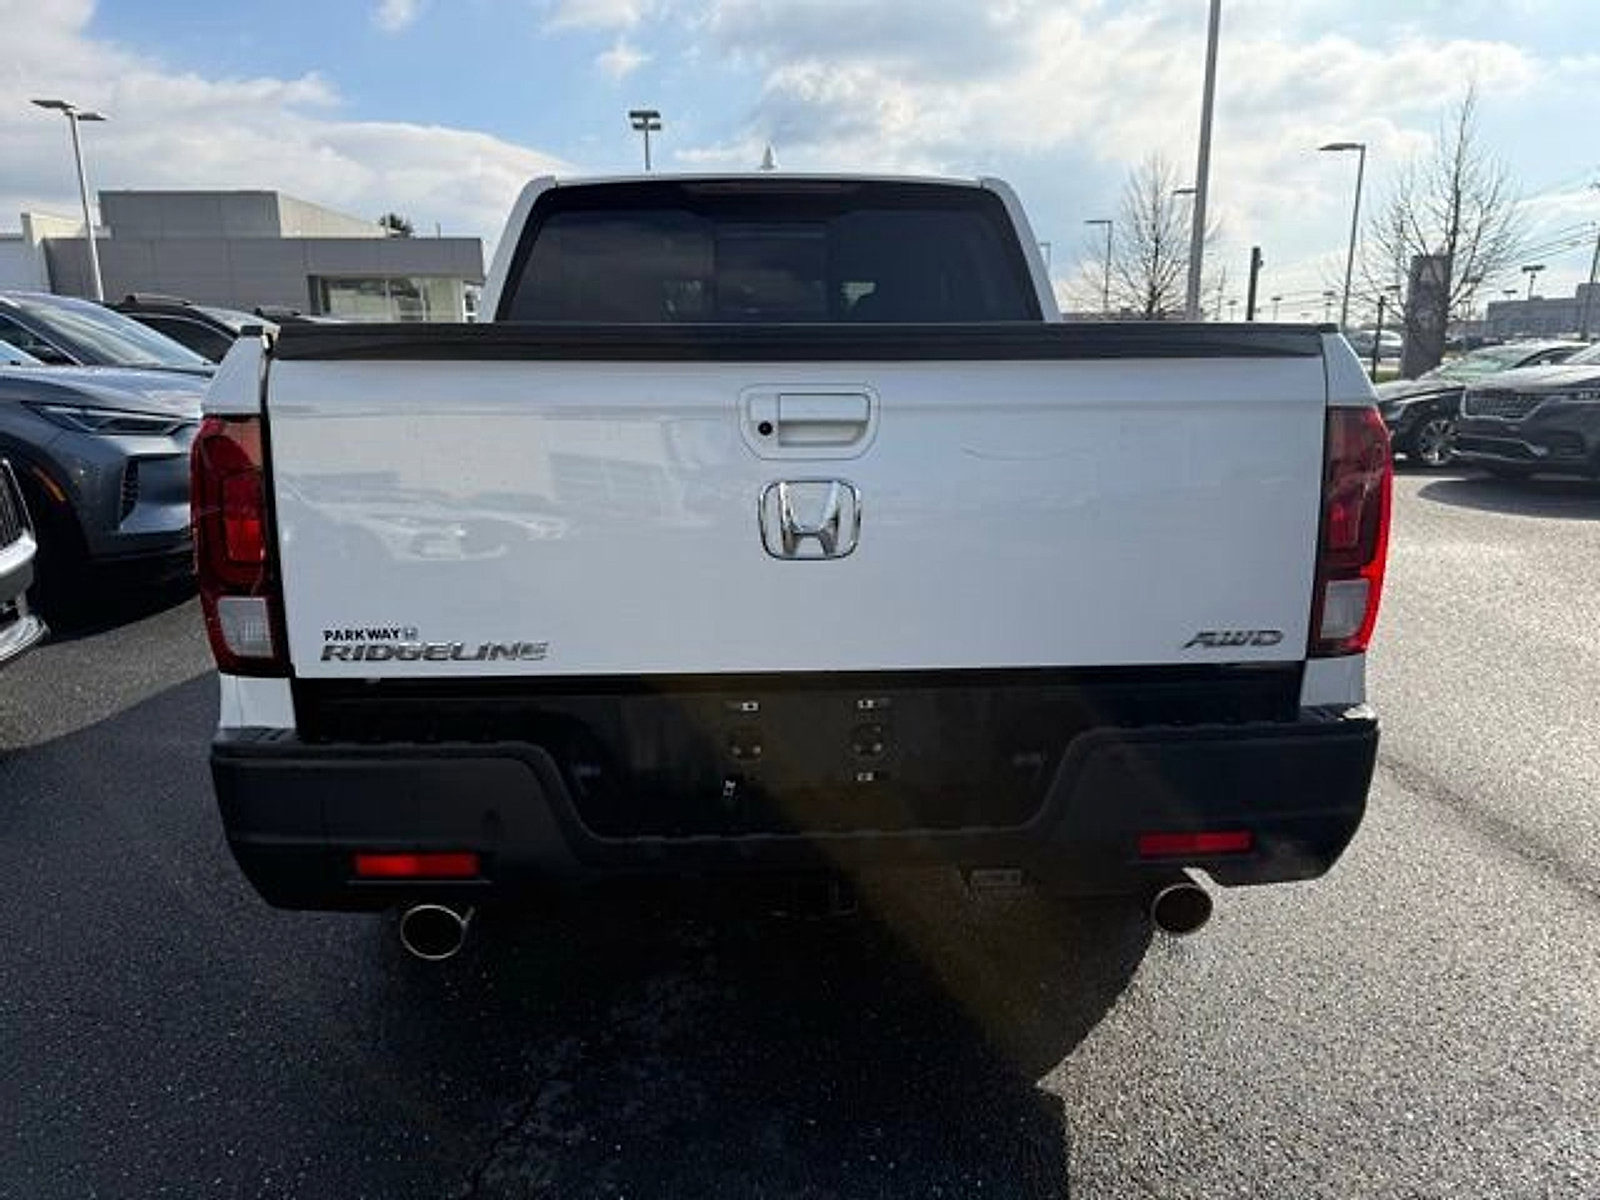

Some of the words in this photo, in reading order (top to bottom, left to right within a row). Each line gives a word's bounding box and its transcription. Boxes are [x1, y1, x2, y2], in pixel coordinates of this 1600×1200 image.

[323, 629, 401, 641] PARKWAY
[1182, 629, 1284, 649] AWD
[319, 641, 550, 662] RIDGELINE
